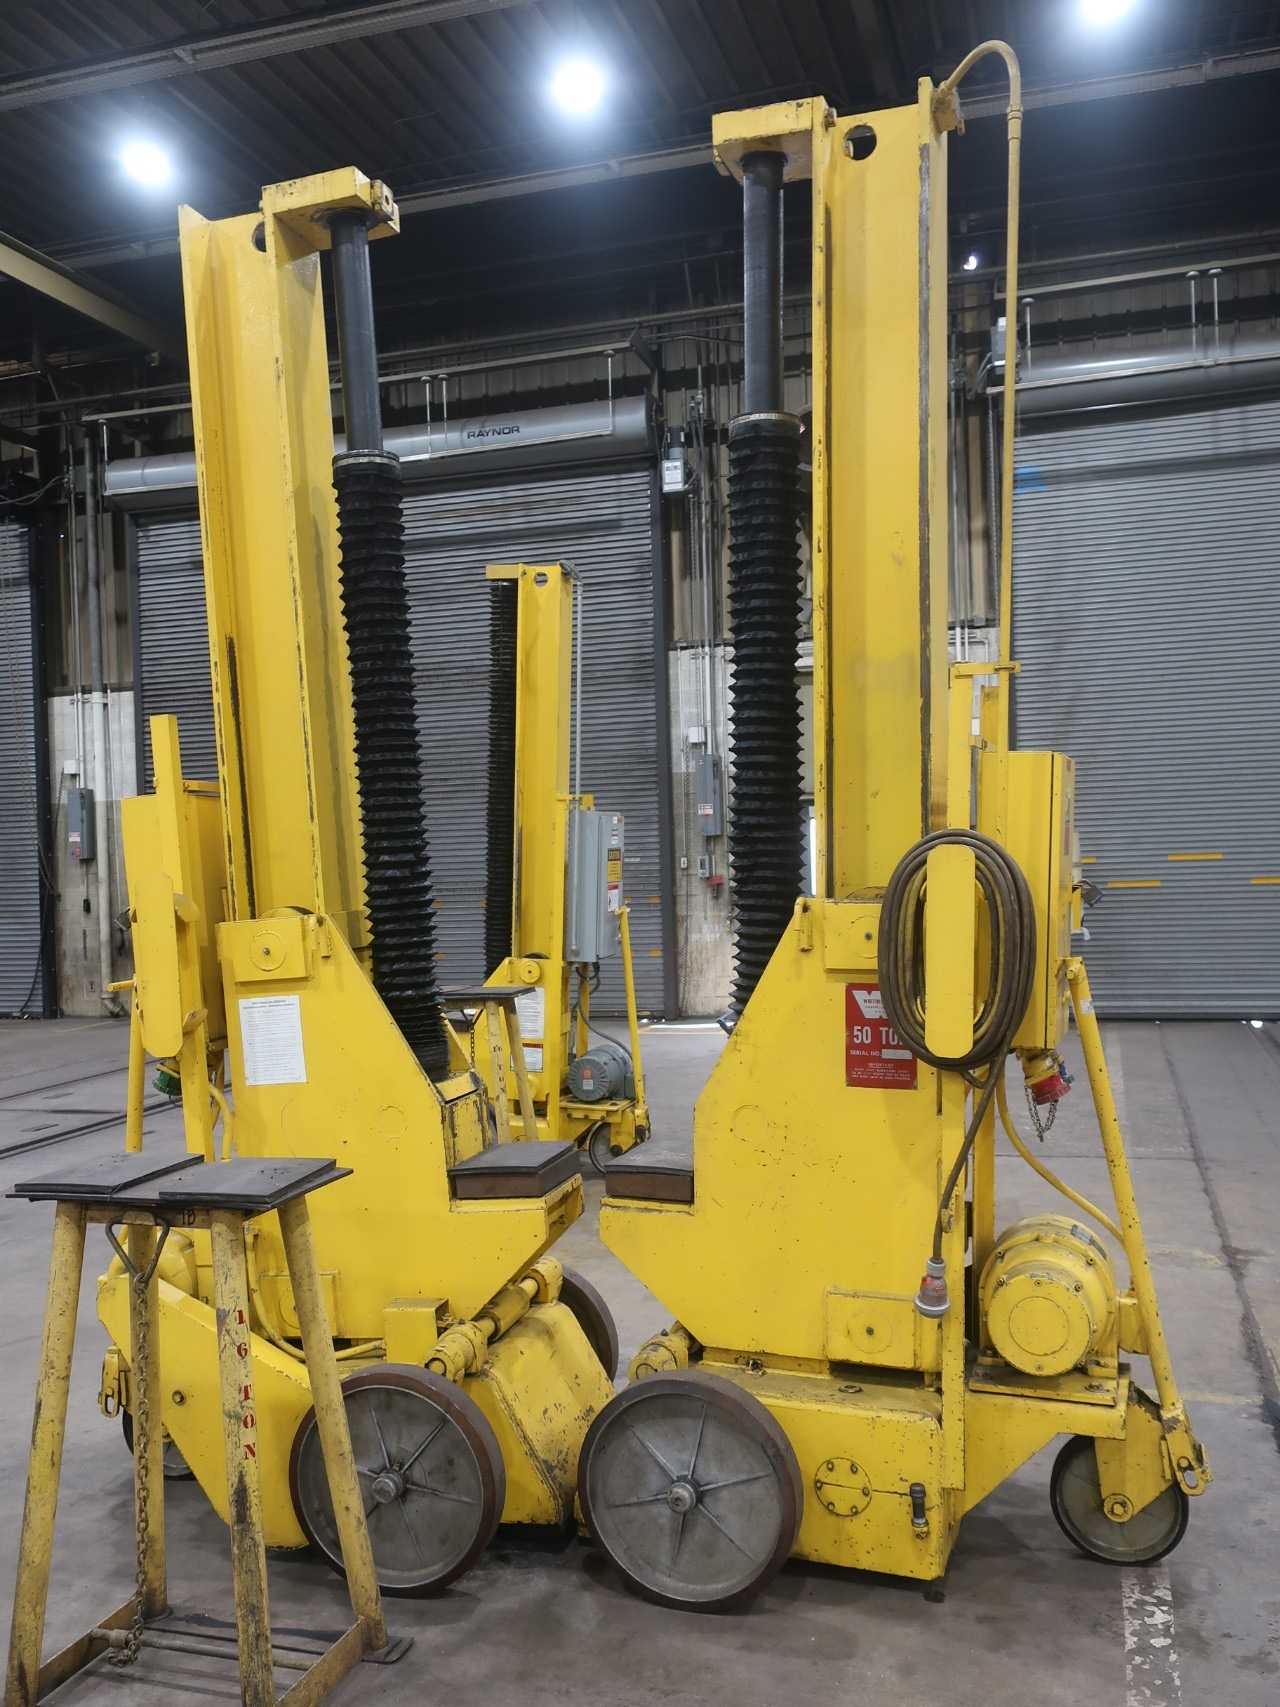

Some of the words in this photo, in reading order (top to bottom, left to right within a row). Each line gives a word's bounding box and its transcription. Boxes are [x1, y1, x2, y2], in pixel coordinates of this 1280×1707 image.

[467, 425, 520, 439] RAYNOR
[853, 1026, 872, 1044] 50
[879, 1026, 903, 1046] TO
[241, 1384, 256, 1459] TON
